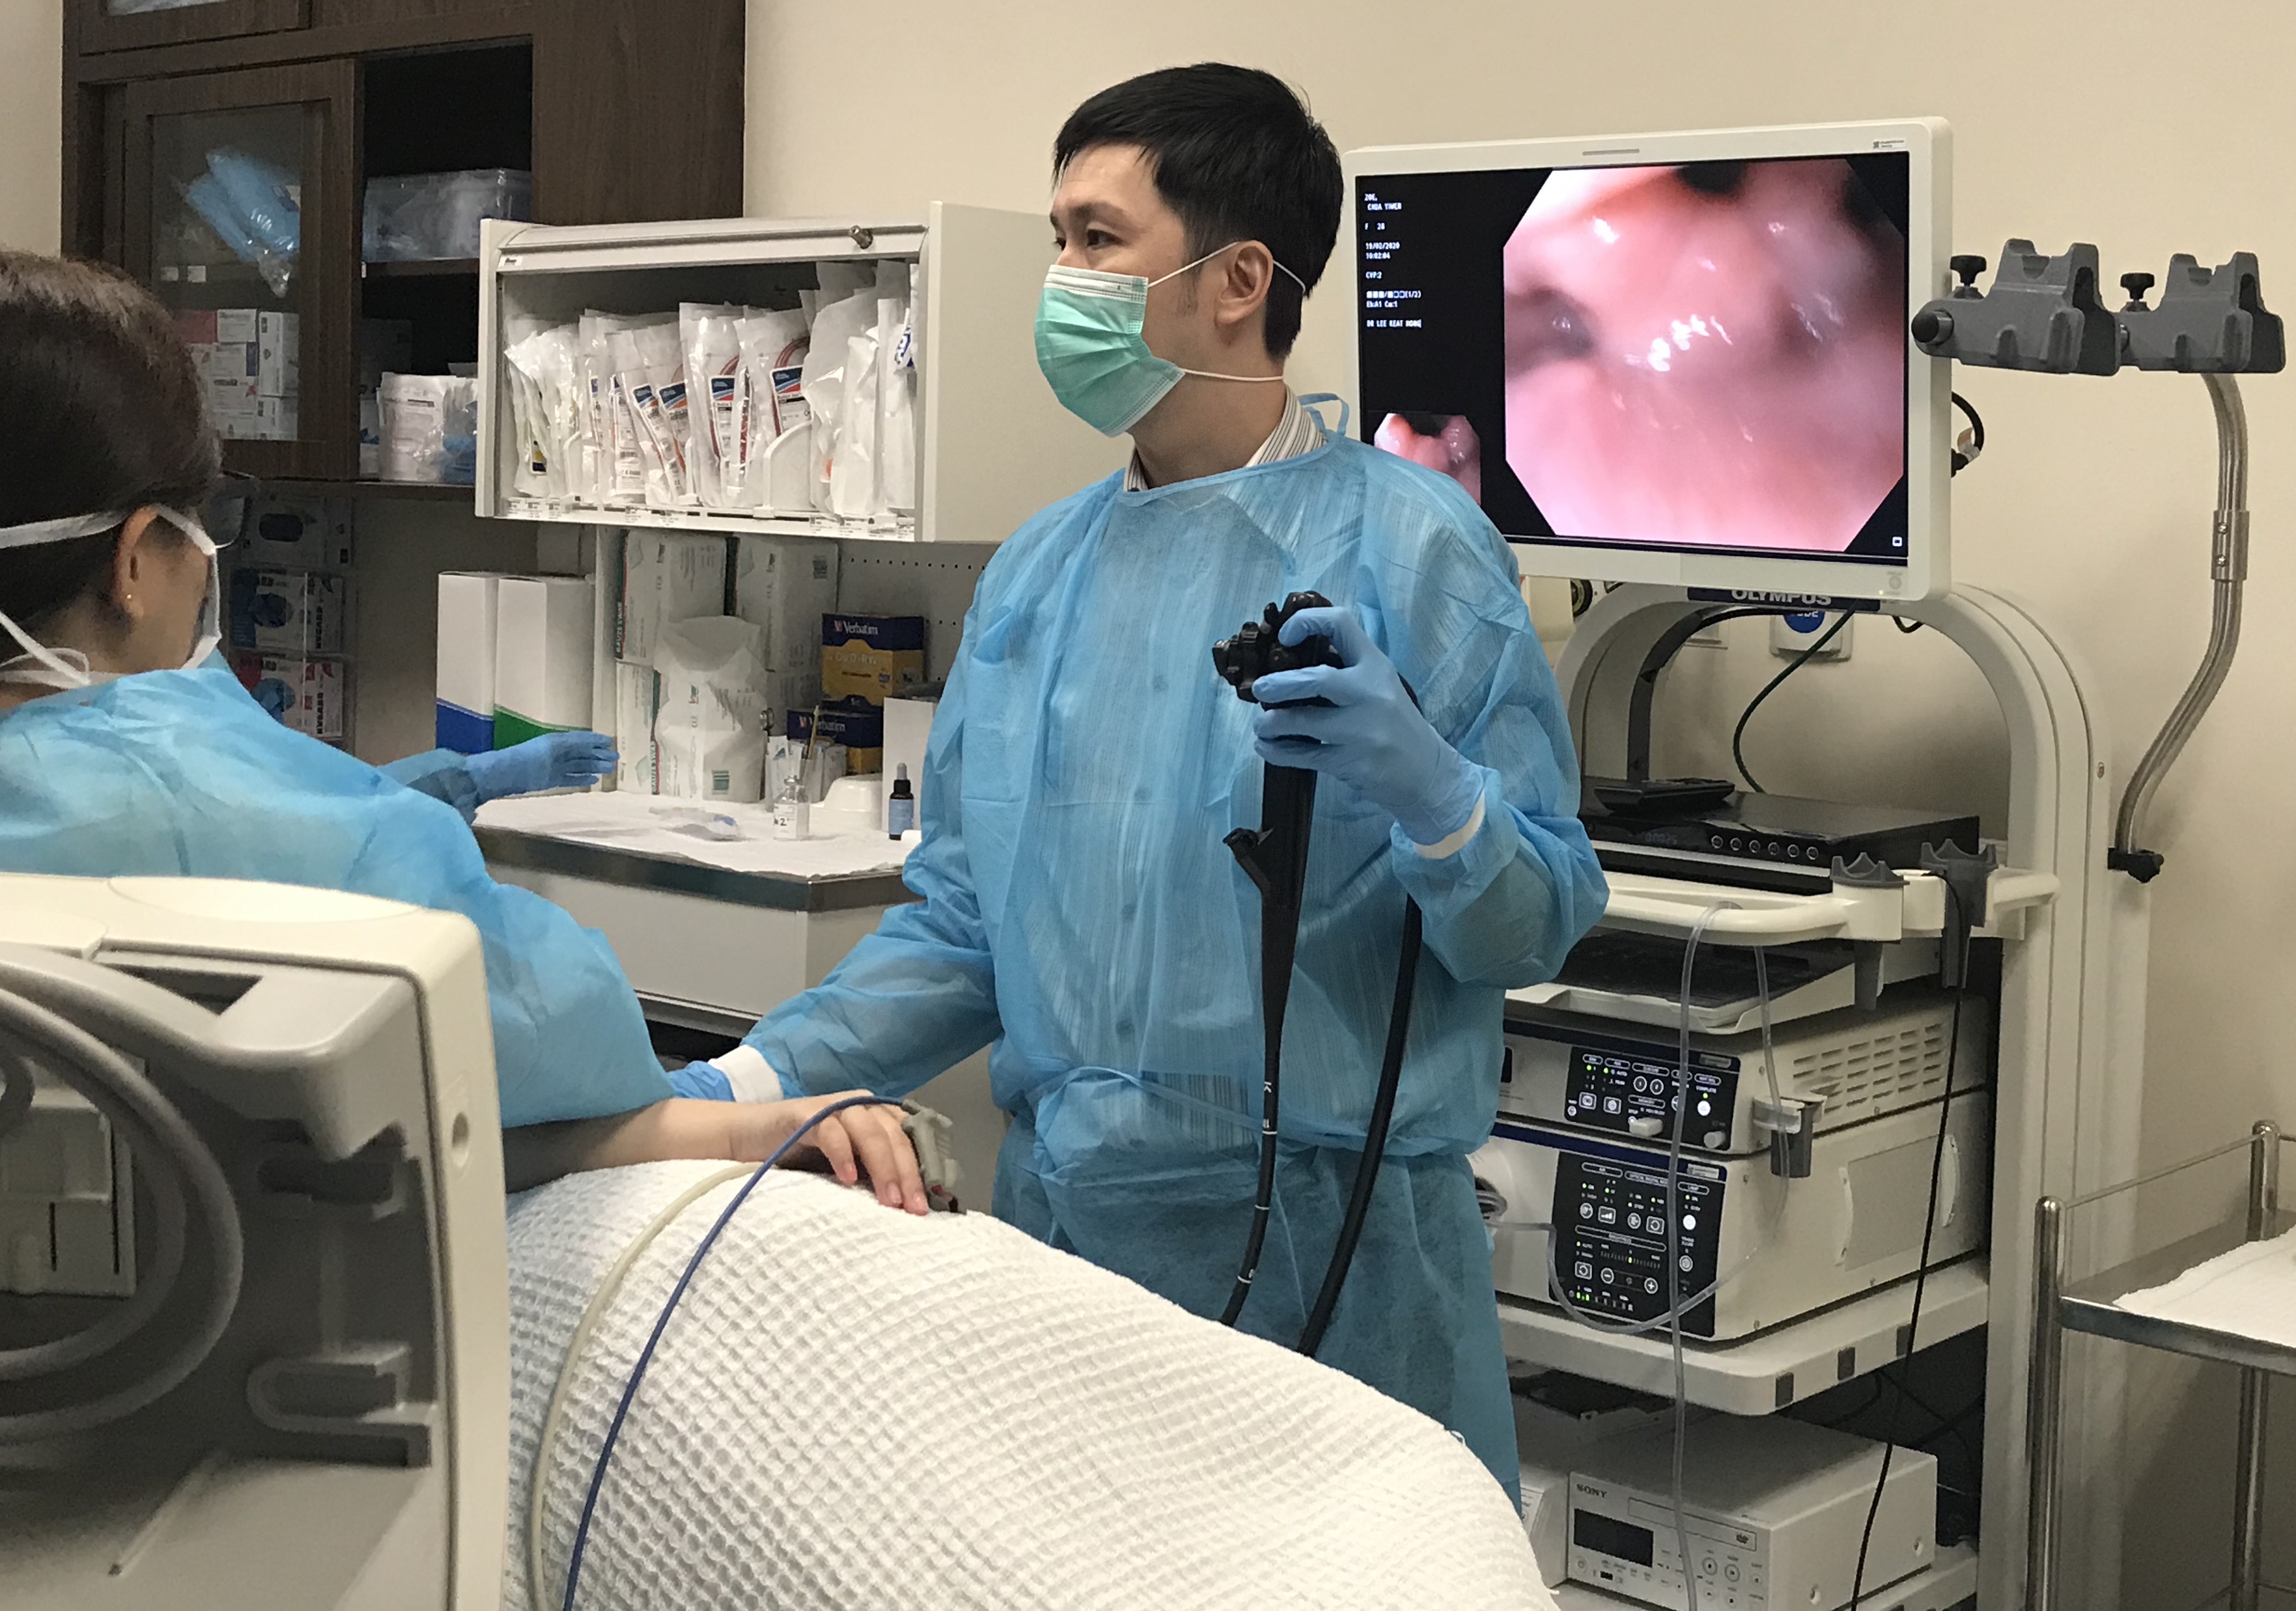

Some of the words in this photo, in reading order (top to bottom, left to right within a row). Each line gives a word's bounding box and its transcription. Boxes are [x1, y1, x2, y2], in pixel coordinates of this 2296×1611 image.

[1731, 590, 1832, 606] OLYMPUS
[843, 619, 878, 635] Verbatim
[1576, 1483, 1608, 1498] SONY
